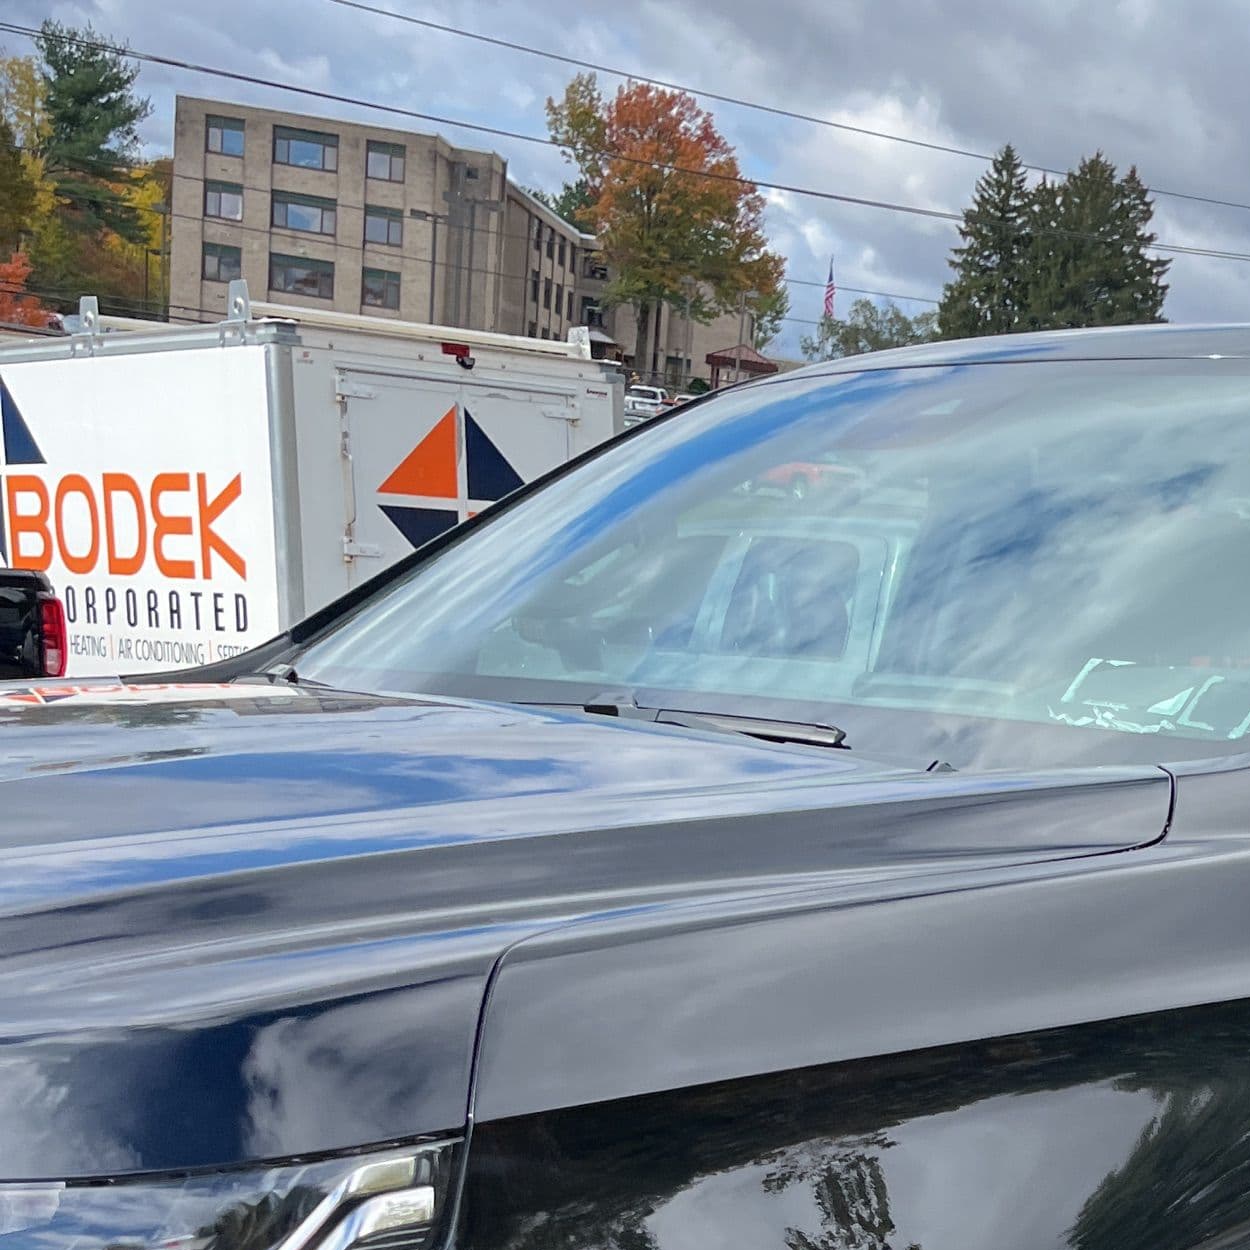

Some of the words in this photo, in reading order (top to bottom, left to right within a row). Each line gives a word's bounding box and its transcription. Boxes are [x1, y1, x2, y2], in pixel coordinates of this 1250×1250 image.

[6, 472, 247, 581] BODEK
[50, 585, 249, 633] ORPORATED
[70, 634, 107, 658] HEATING
[118, 638, 133, 660] AIR
[135, 638, 205, 665] CONDITIONING
[217, 644, 249, 659] SEPT
